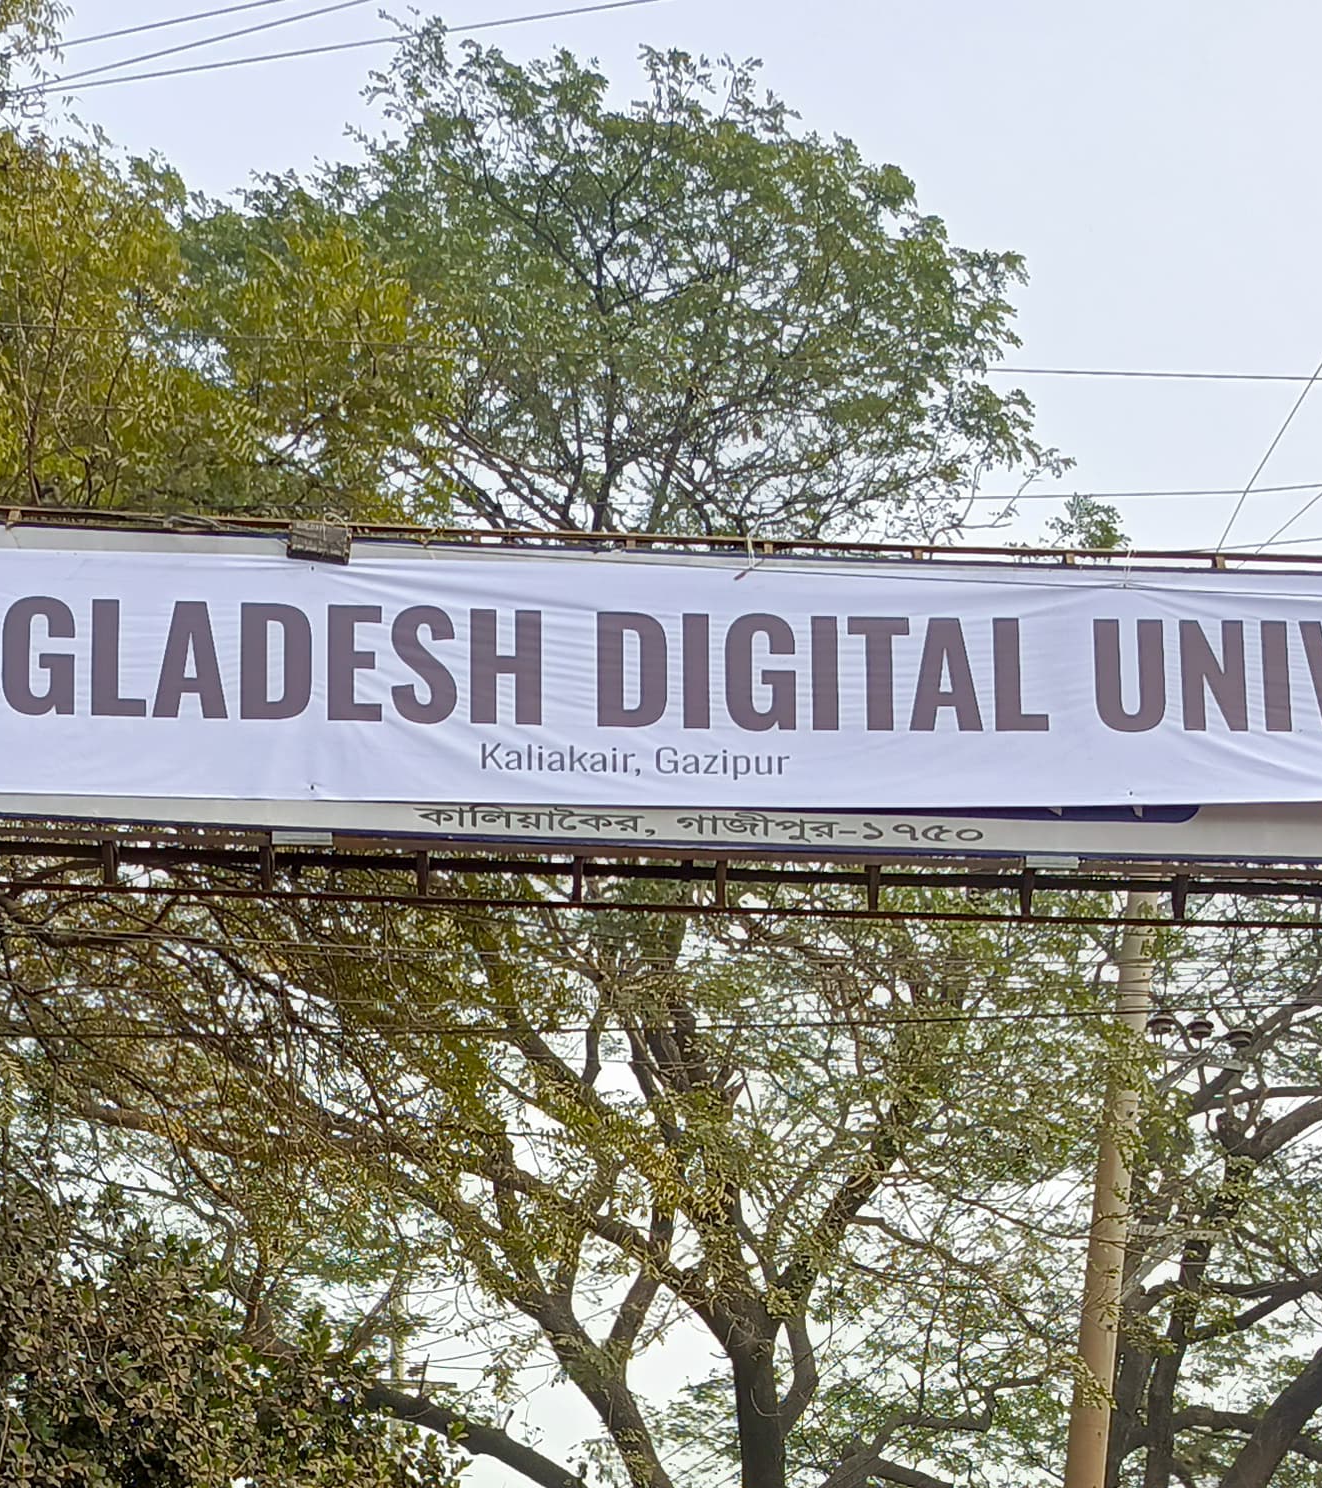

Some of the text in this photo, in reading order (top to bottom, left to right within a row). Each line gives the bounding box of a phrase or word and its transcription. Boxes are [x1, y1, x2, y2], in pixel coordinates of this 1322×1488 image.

[596, 611, 1051, 734] DIGITAL
[479, 741, 791, 782] Kaliakair, Gazipur
